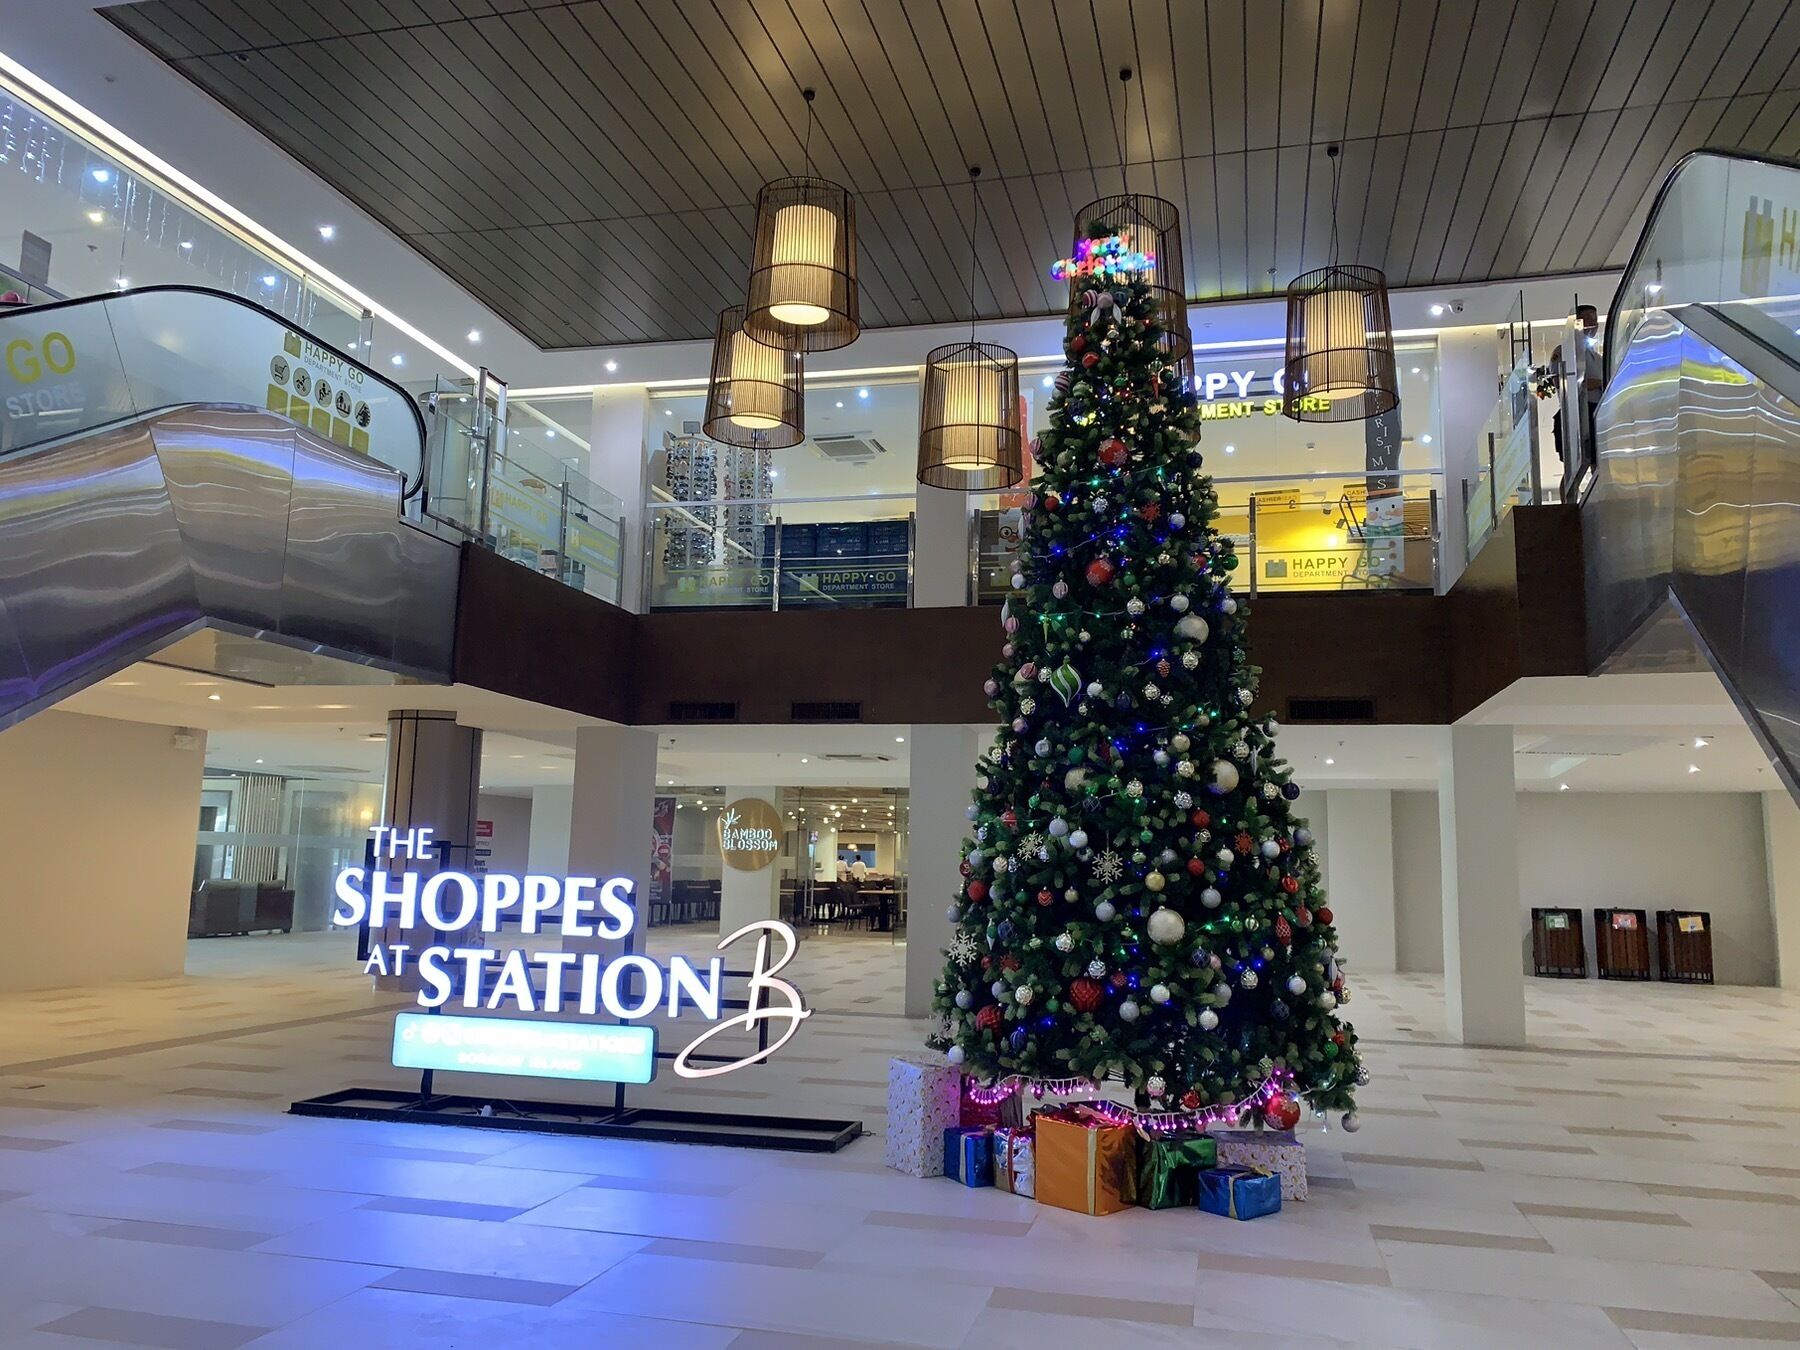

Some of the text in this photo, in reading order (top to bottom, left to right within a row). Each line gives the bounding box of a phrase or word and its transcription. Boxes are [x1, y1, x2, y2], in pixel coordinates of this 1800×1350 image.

[5, 332, 76, 384] GO
[304, 341, 364, 384] HAPPY GO
[304, 356, 362, 393] DEPARTMENT STORE
[1289, 499, 1296, 509] 2
[1292, 556, 1381, 570] HAPPY GO
[750, 574, 771, 586] GO
[822, 571, 896, 584] HAPPY GO
[1293, 570, 1347, 578] DEPARTMENT
[723, 828, 773, 840] BAMBOO
[369, 826, 434, 860] THE
[723, 839, 778, 851] BLOSSOM
[333, 867, 635, 940] SHOPPES
[363, 943, 410, 976] AT
[417, 946, 723, 1020] STATION
[673, 919, 812, 1079] B
